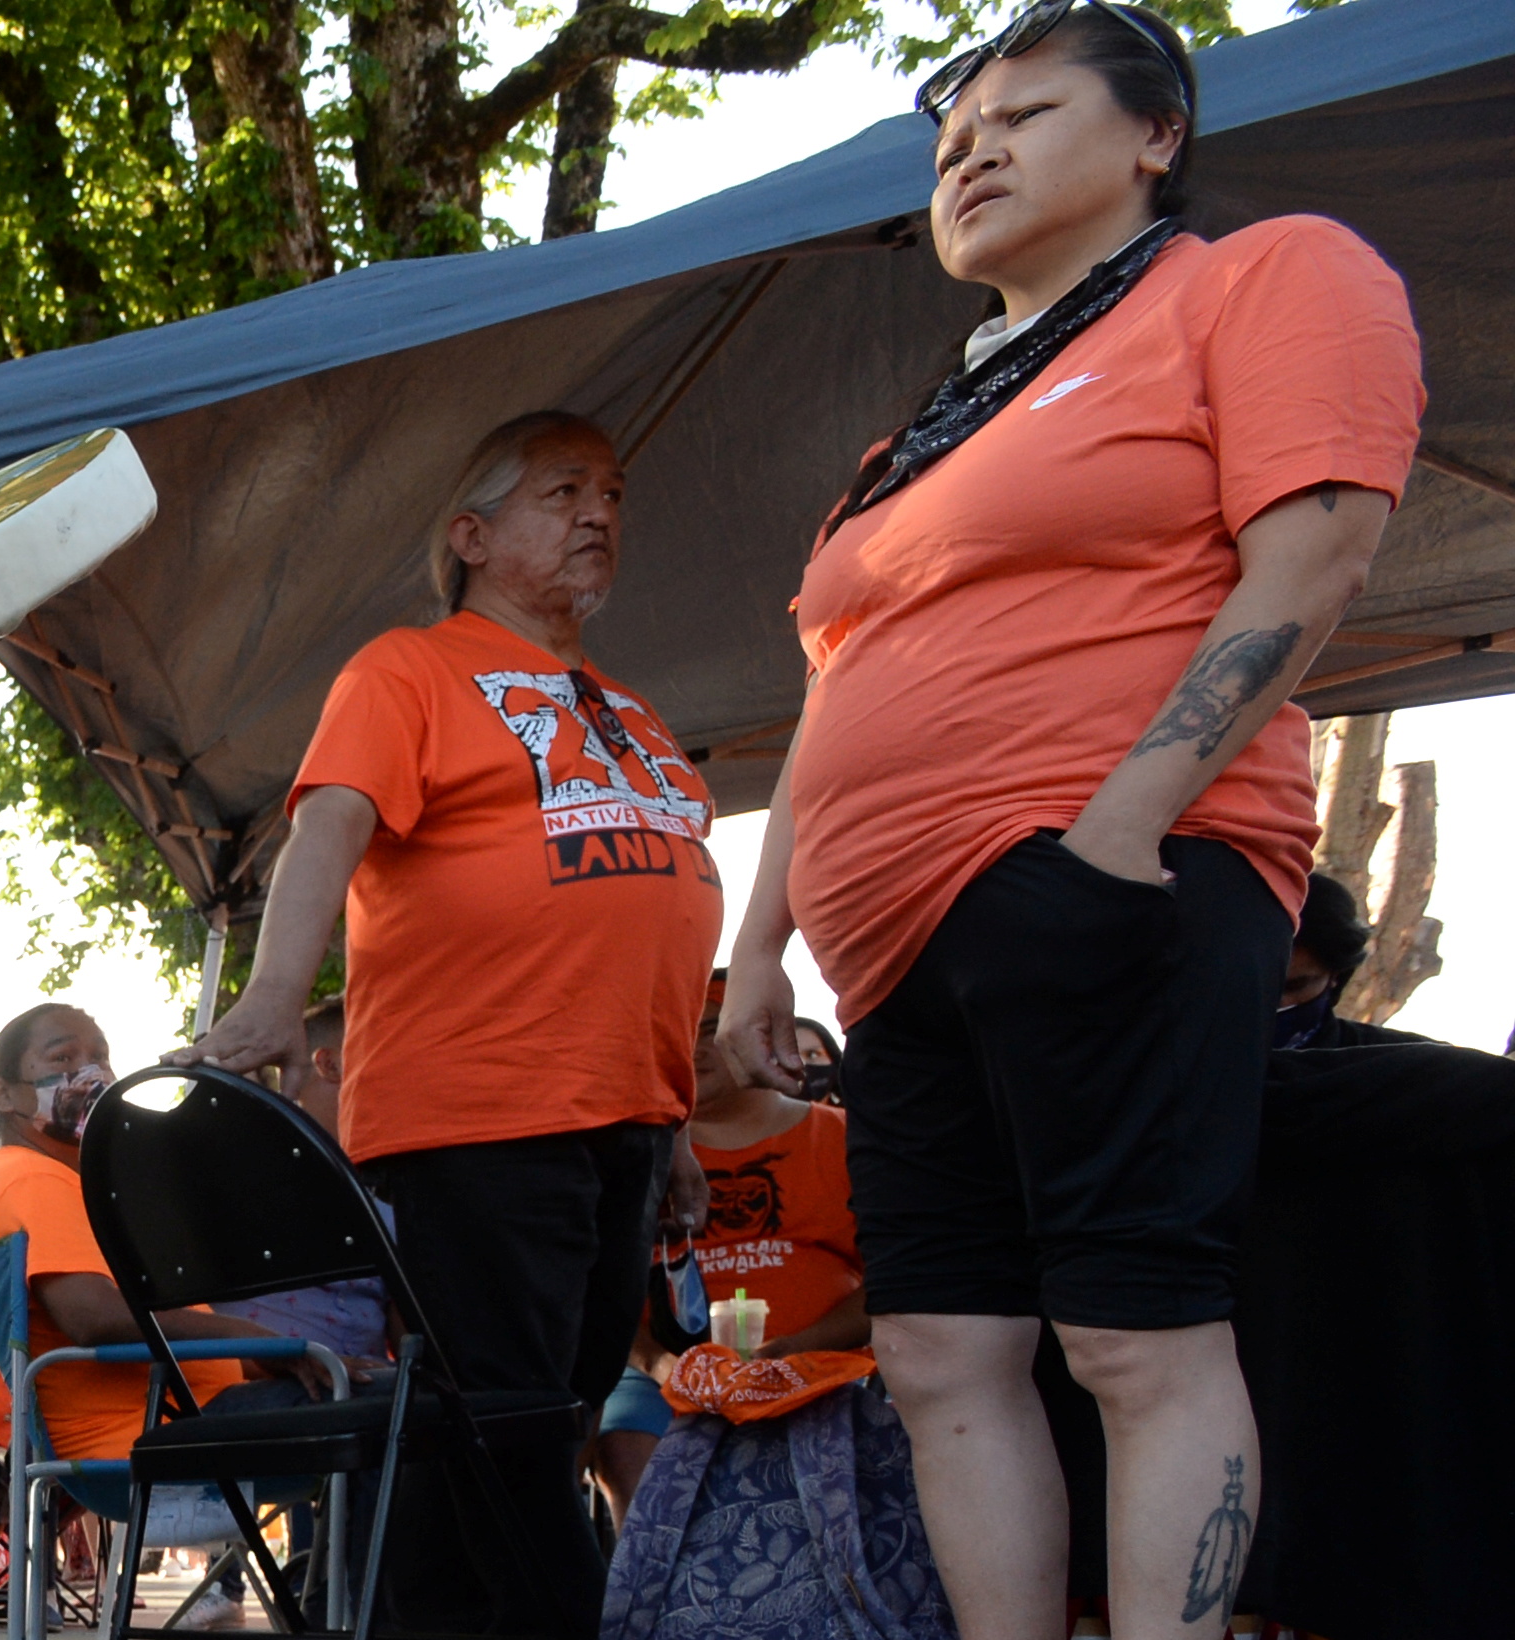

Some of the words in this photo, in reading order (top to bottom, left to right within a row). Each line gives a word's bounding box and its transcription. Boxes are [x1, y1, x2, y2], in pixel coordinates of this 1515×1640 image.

[546, 805, 638, 832] NATIVE
[646, 813, 687, 833] LIVES
[547, 832, 673, 881] LAND
